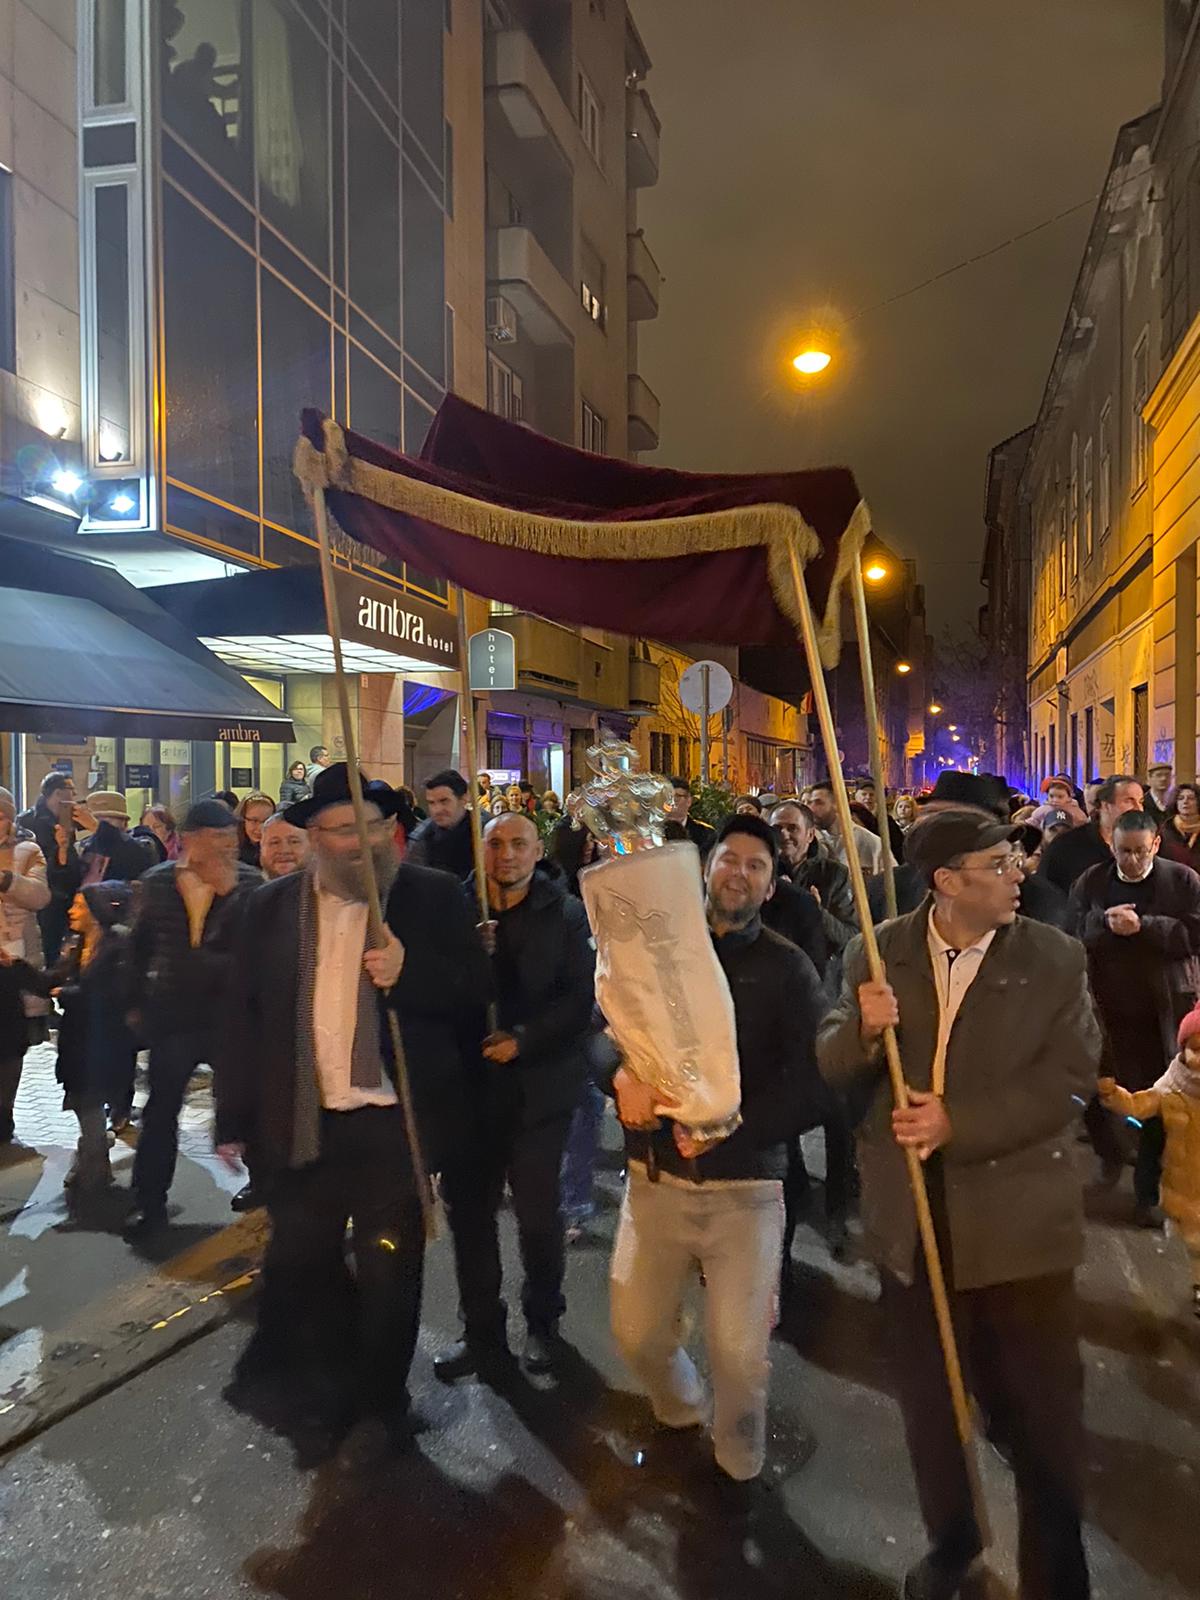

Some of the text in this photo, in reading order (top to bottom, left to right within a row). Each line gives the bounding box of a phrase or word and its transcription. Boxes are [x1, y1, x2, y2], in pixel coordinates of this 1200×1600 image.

[359, 595, 453, 653] ambra hotel
[488, 632, 496, 686] hotel
[218, 723, 260, 741] ambra
